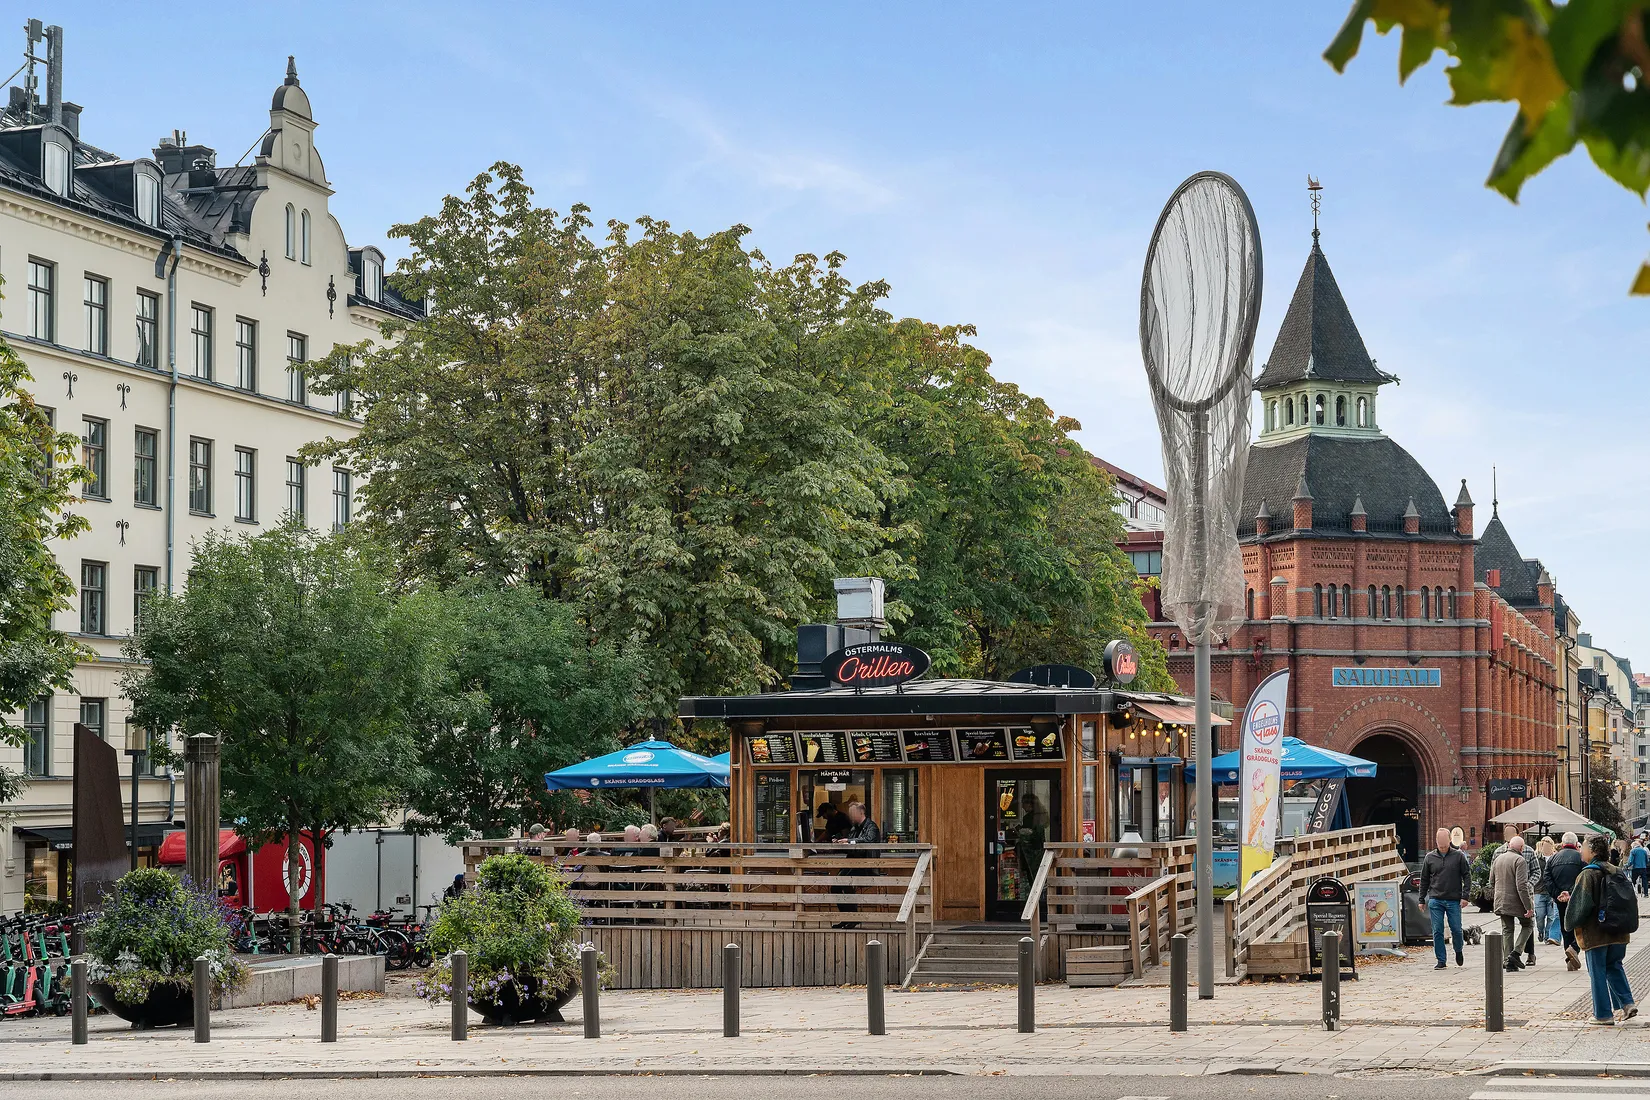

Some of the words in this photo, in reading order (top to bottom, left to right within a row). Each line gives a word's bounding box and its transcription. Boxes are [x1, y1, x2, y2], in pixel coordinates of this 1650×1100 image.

[845, 645, 903, 656] ÖSTERMALMS
[838, 655, 914, 682] Grillen
[1254, 747, 1273, 755] SKÄNSK
[1246, 754, 1279, 765] GRÄDDGLASS
[1312, 793, 1332, 829] BYGG
[1313, 912, 1328, 920] Special
